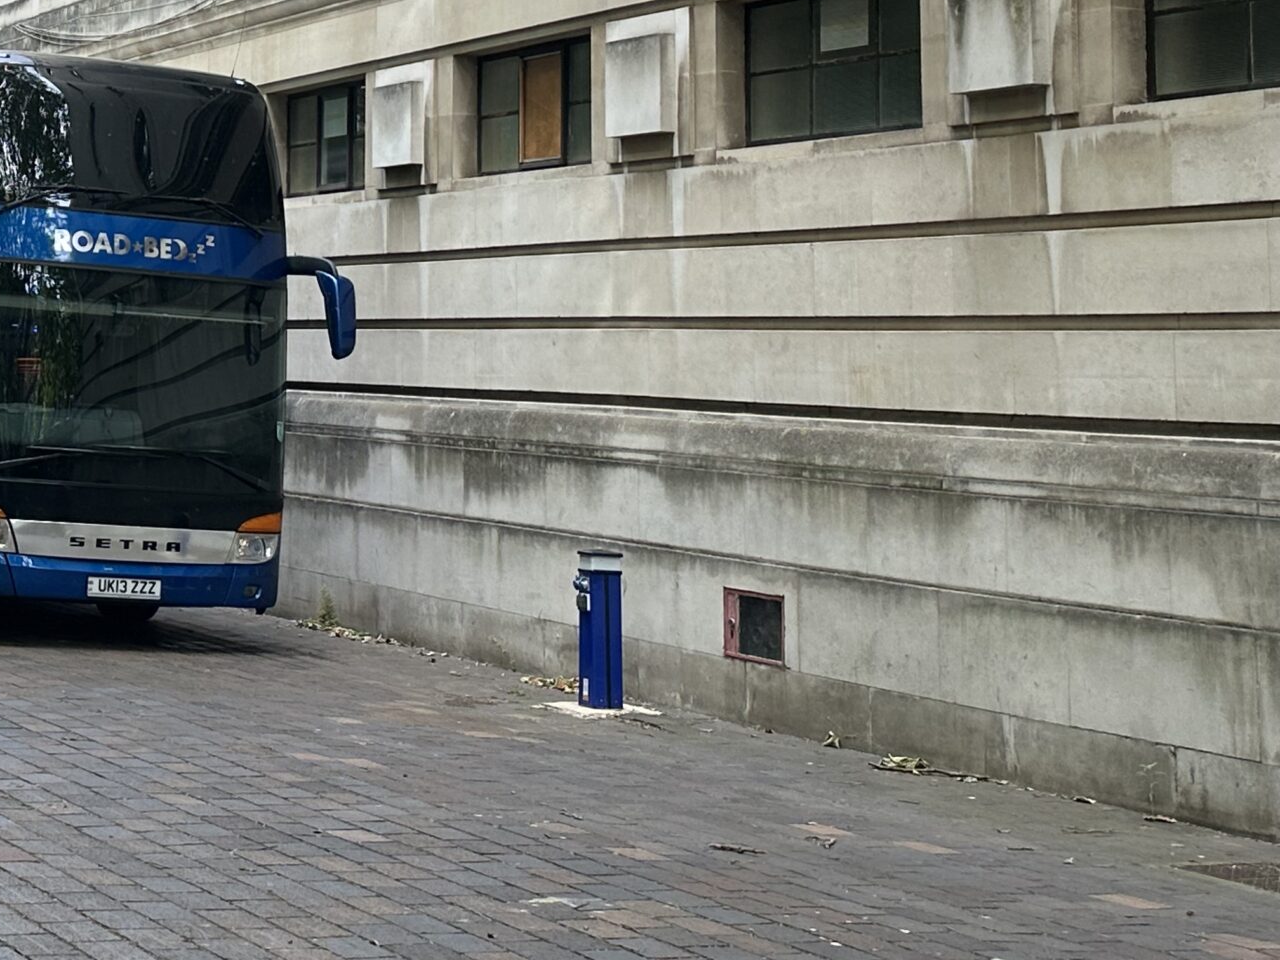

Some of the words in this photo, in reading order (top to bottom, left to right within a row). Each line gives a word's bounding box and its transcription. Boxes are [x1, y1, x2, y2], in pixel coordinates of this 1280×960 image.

[53, 228, 131, 256] ROAD
[69, 536, 181, 552] SETRA
[98, 579, 128, 593] UK13
[130, 580, 157, 595] ZZZ
